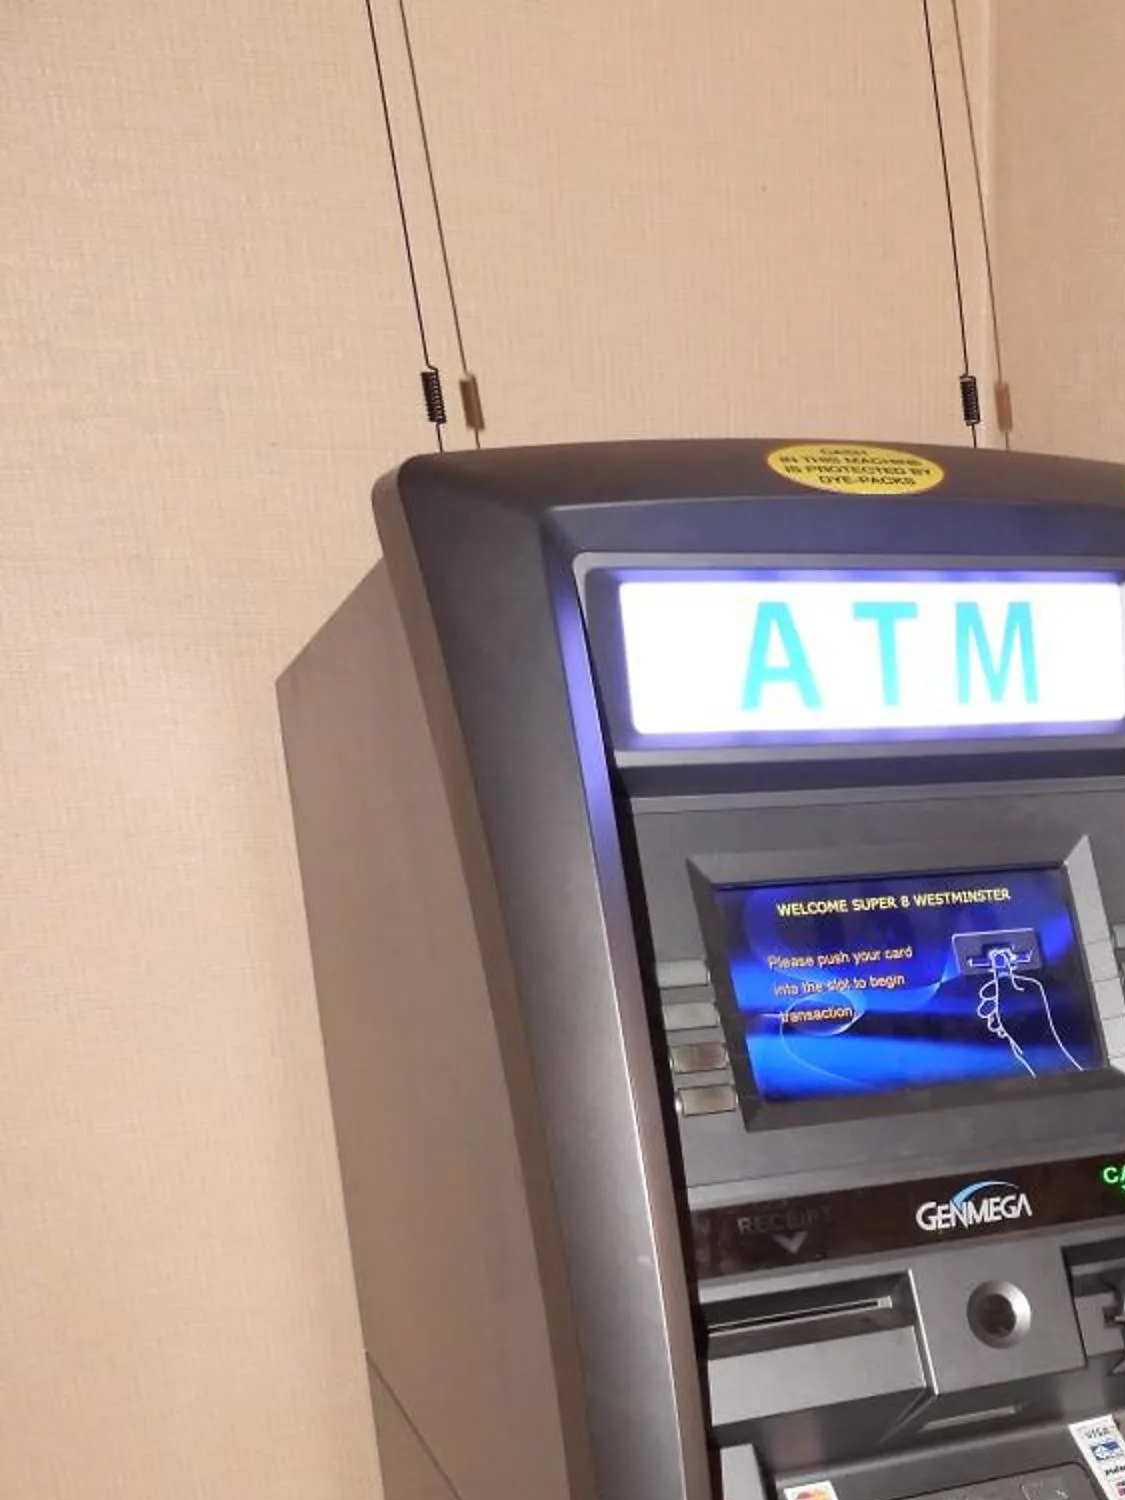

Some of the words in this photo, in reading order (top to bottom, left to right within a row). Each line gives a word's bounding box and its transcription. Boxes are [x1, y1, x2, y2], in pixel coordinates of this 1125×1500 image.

[804, 456, 842, 465] THIS
[844, 457, 923, 467] MACHINE
[805, 465, 907, 475] PROTECTED
[911, 468, 931, 476] BY
[740, 601, 1039, 711] ATM
[776, 900, 849, 917] WELCOME
[852, 897, 898, 912] SUPER
[901, 896, 910, 908] 8
[913, 888, 1011, 907] WESTMINSTER
[767, 954, 814, 969] Please
[817, 951, 850, 969] push
[853, 949, 882, 965] your
[885, 946, 913, 960] card
[773, 983, 799, 997] into
[803, 980, 824, 994] the
[828, 978, 851, 992] slot
[853, 978, 866, 989] to
[870, 974, 905, 991] begin
[780, 1005, 855, 1024] transaction
[915, 1193, 1033, 1231] GENMEGA
